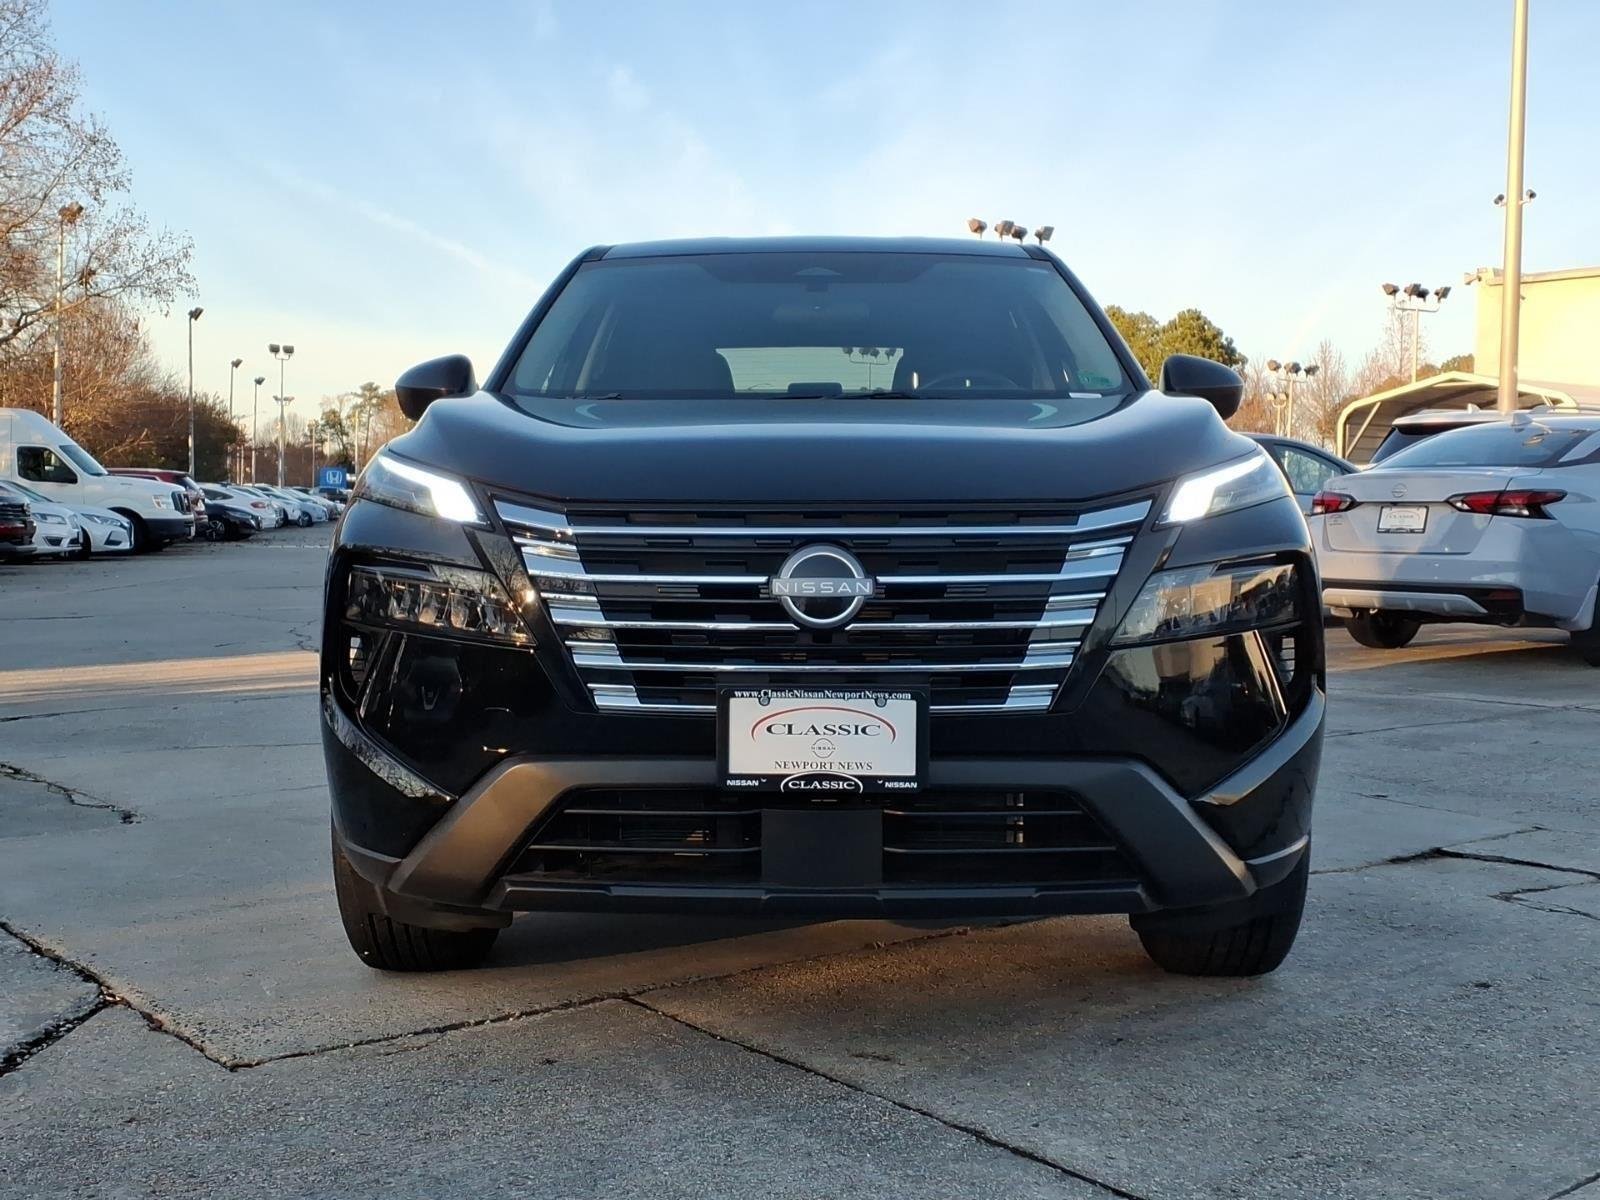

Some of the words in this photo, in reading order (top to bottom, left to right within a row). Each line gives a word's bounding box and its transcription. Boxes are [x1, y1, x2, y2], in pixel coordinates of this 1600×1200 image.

[774, 581, 871, 594] NISSAN
[734, 689, 911, 701] www.ClassicNissanNewportNews.com
[766, 723, 881, 737] CLASSIC
[774, 760, 835, 771] NEWPORT
[837, 760, 873, 771] NEWS
[726, 779, 759, 787] NISSAN
[788, 780, 855, 790] CLASSIC
[885, 781, 918, 789] NISSAN
